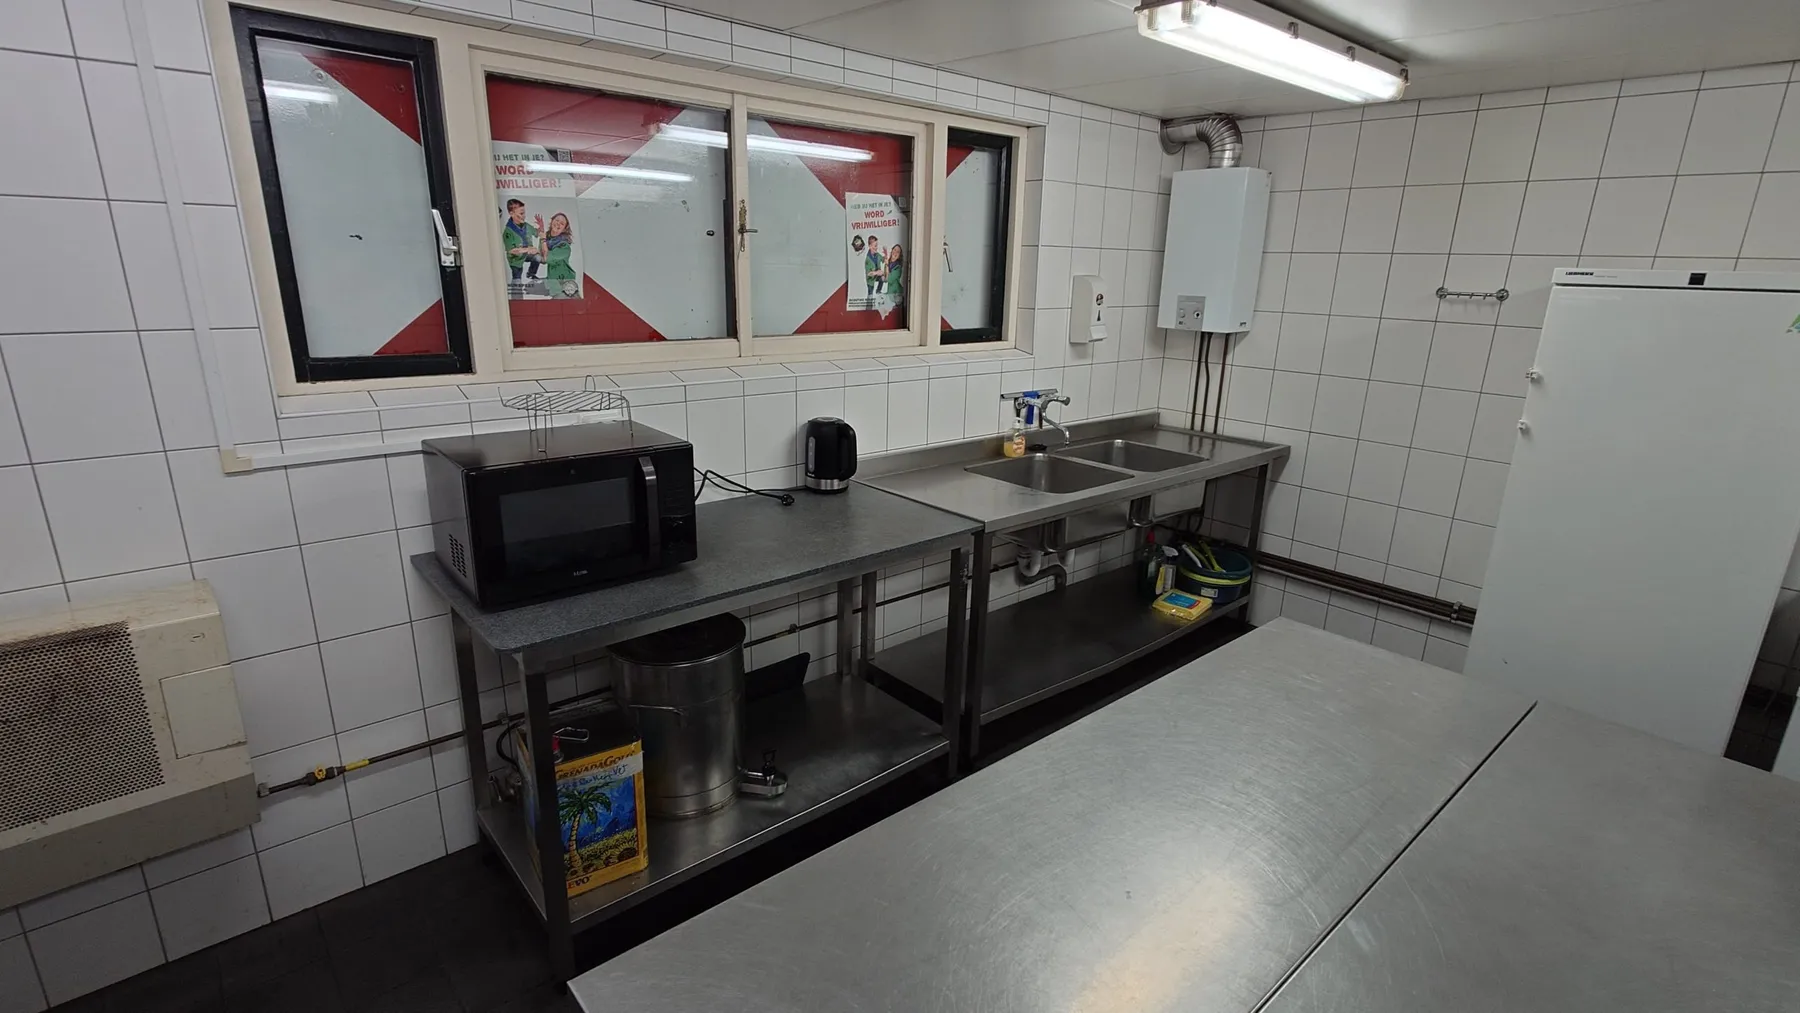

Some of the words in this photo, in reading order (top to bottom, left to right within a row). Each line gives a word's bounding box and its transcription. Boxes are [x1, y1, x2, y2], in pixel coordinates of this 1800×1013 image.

[496, 178, 561, 189] JWILLIGER!
[864, 210, 885, 218] WORD
[851, 219, 900, 230] VRIJWILLIGER!
